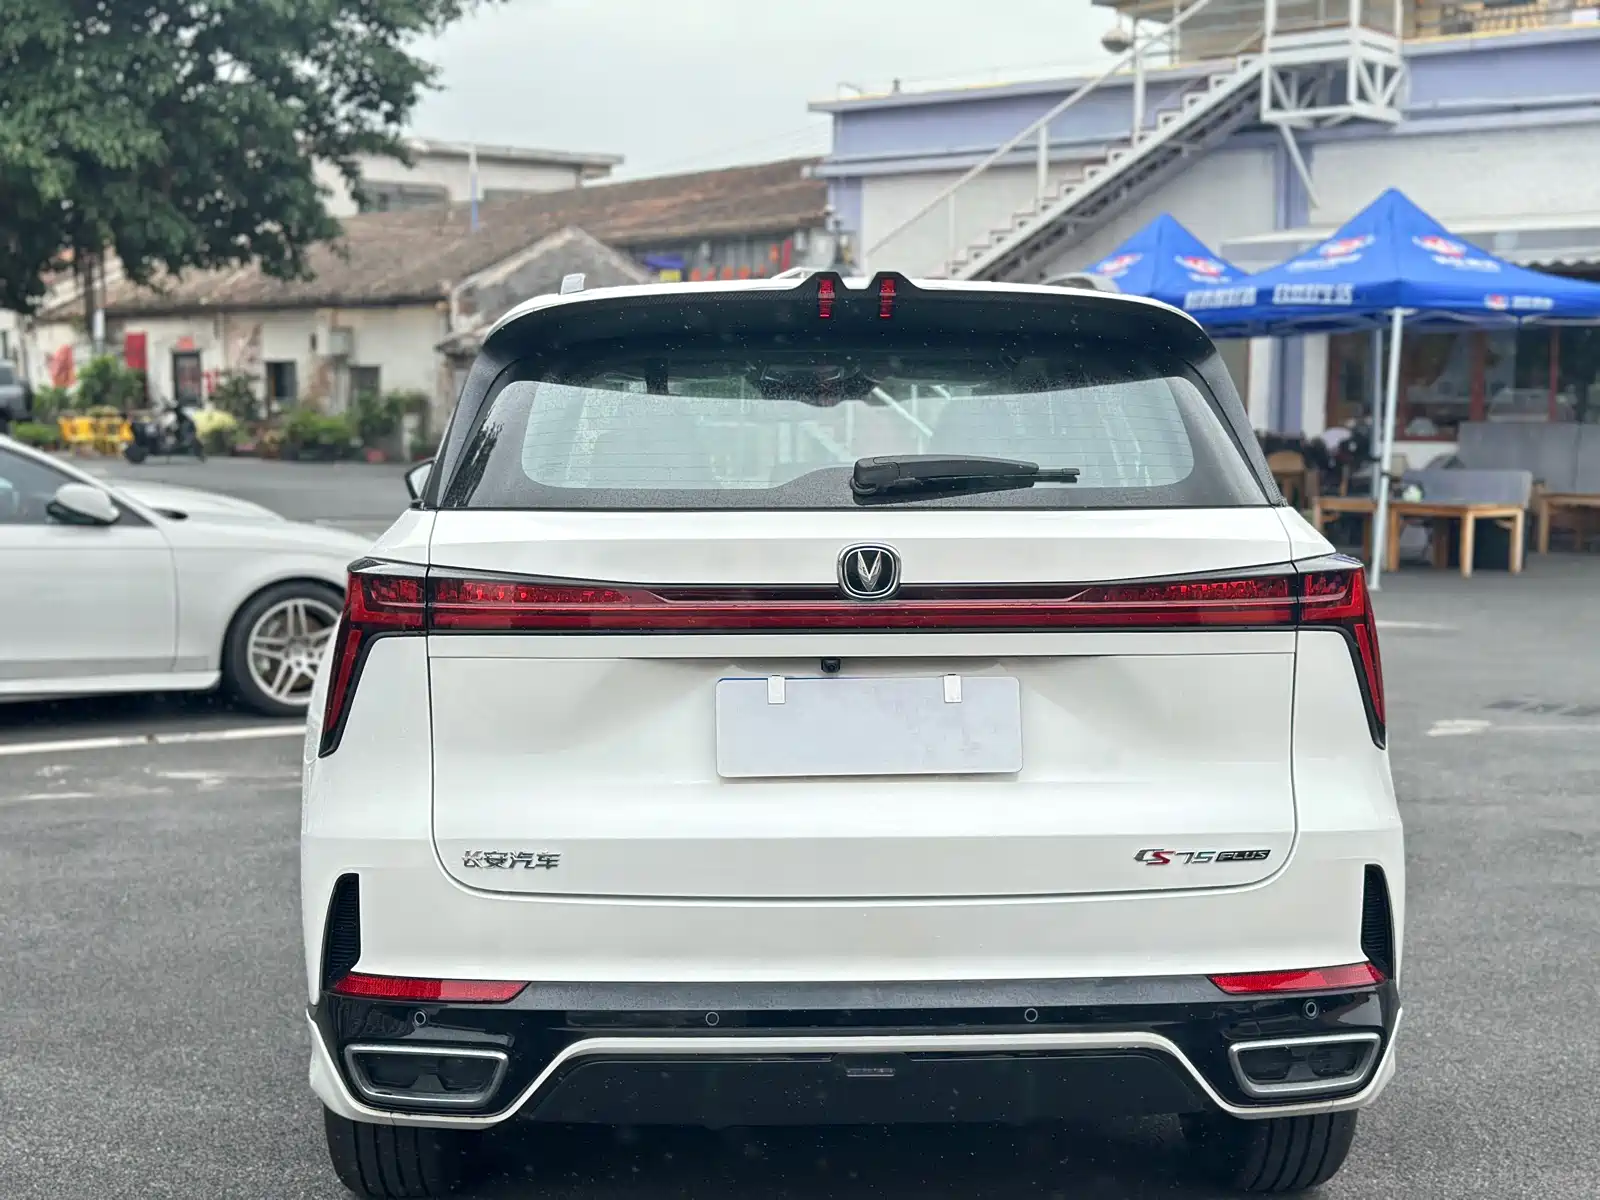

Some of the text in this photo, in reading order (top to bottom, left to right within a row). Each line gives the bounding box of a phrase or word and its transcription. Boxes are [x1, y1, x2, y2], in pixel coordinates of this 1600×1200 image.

[462, 850, 561, 869] 长安汽车
[1218, 850, 1270, 861] PLUS
